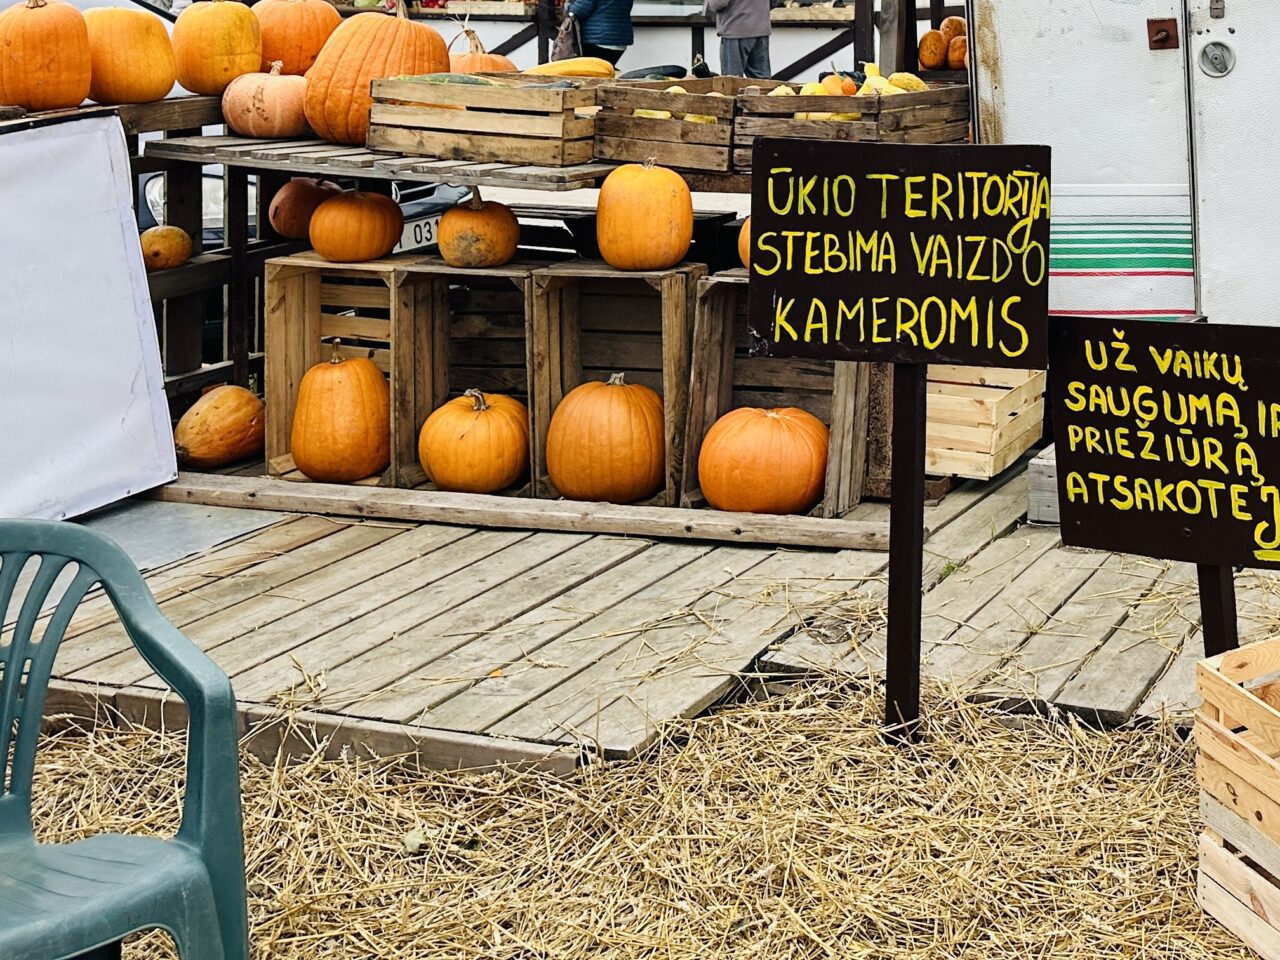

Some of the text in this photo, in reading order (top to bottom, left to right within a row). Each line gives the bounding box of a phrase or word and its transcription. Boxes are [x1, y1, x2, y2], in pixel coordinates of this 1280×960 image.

[768, 167, 1050, 254] ŪKIO TERITORIJA
[753, 229, 1046, 286] STEBIMA VAIZDO
[774, 295, 1029, 358] KAMEROMIS
[1084, 327, 1249, 391] UŽ VAIKŲ
[1064, 381, 1249, 439] SAUGUMĄ
[1068, 418, 1265, 487] PRIEŽIŪRĄ
[1066, 471, 1253, 521] ATSAKOTE
